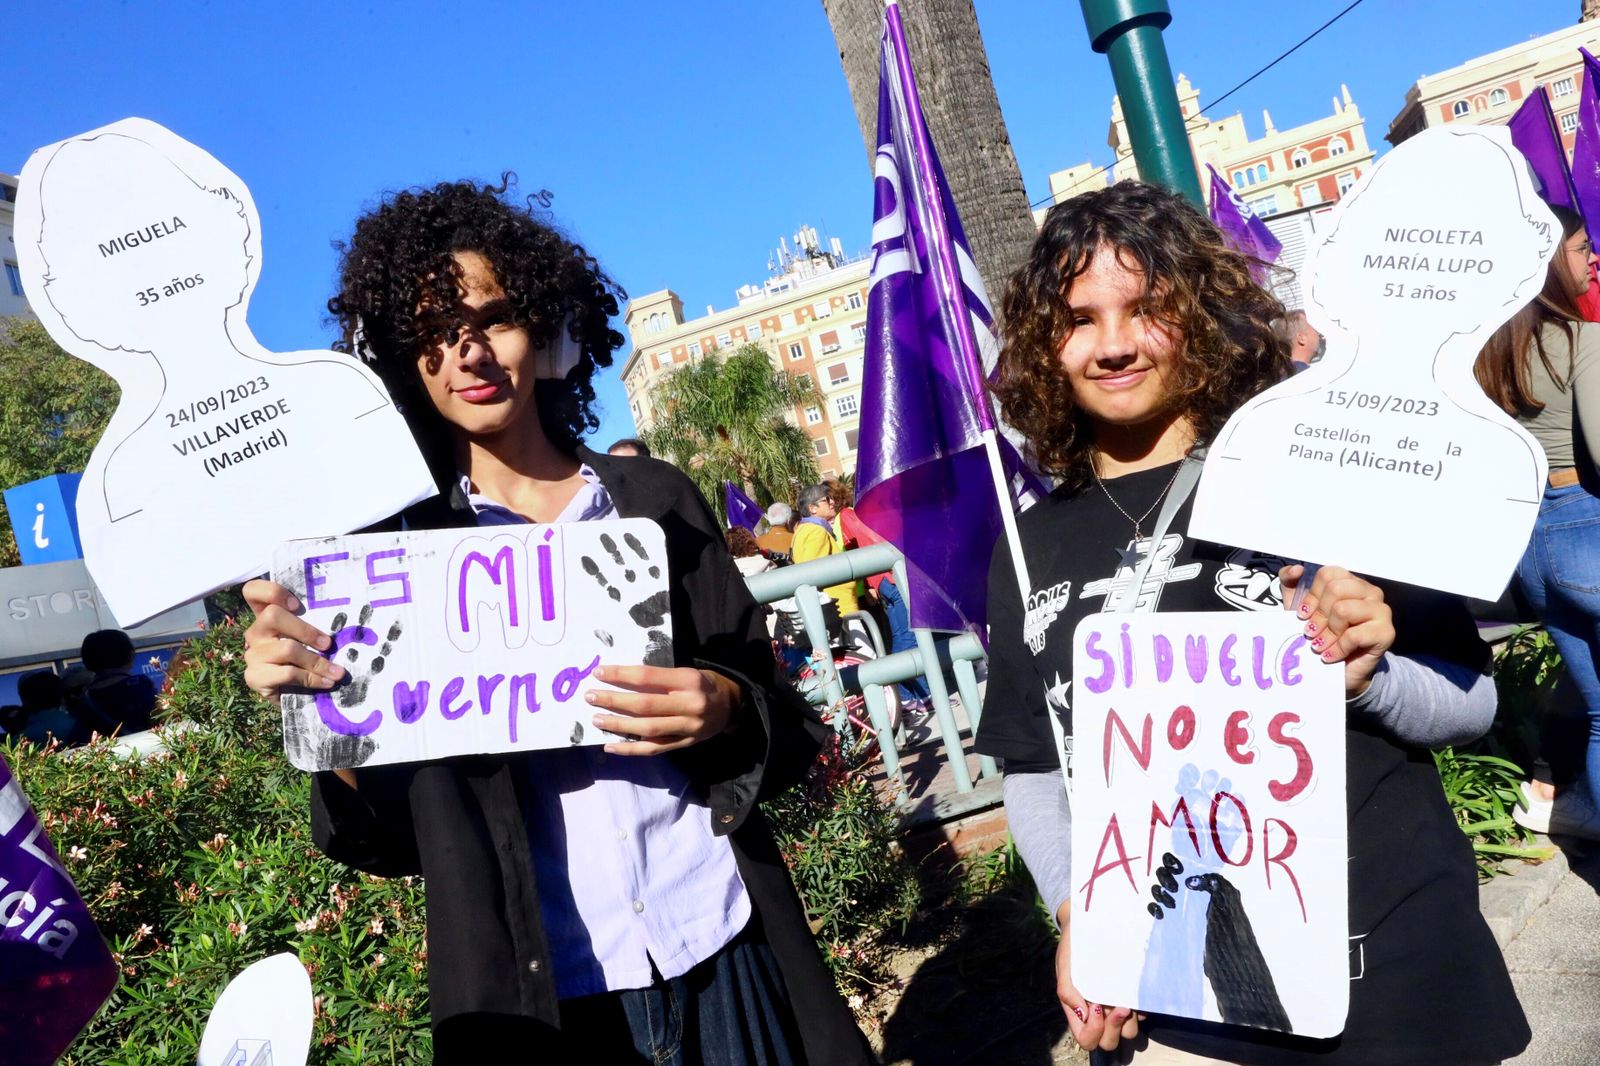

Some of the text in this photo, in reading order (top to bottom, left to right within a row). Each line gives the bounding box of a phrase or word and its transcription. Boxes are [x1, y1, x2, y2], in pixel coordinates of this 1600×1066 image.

[97, 216, 187, 258] MIGUELA
[1384, 228, 1483, 245] NICOLETA
[1363, 251, 1493, 274] MARÍA LUPO
[135, 274, 205, 307] 35 años
[1383, 283, 1457, 301] 51 años
[165, 376, 270, 423] 24/09/2023
[1325, 390, 1439, 417] 15/09/2023
[172, 399, 291, 457] VILLAVERDE
[1294, 422, 1463, 457] Castellón de la
[203, 428, 288, 478] (Madrid)
[1288, 444, 1443, 482] Plana (Alicante)
[304, 548, 413, 610] ES
[1153, 633, 1307, 690] DUELE
[1104, 705, 1197, 788] NO
[1079, 791, 1308, 923] AMOR
